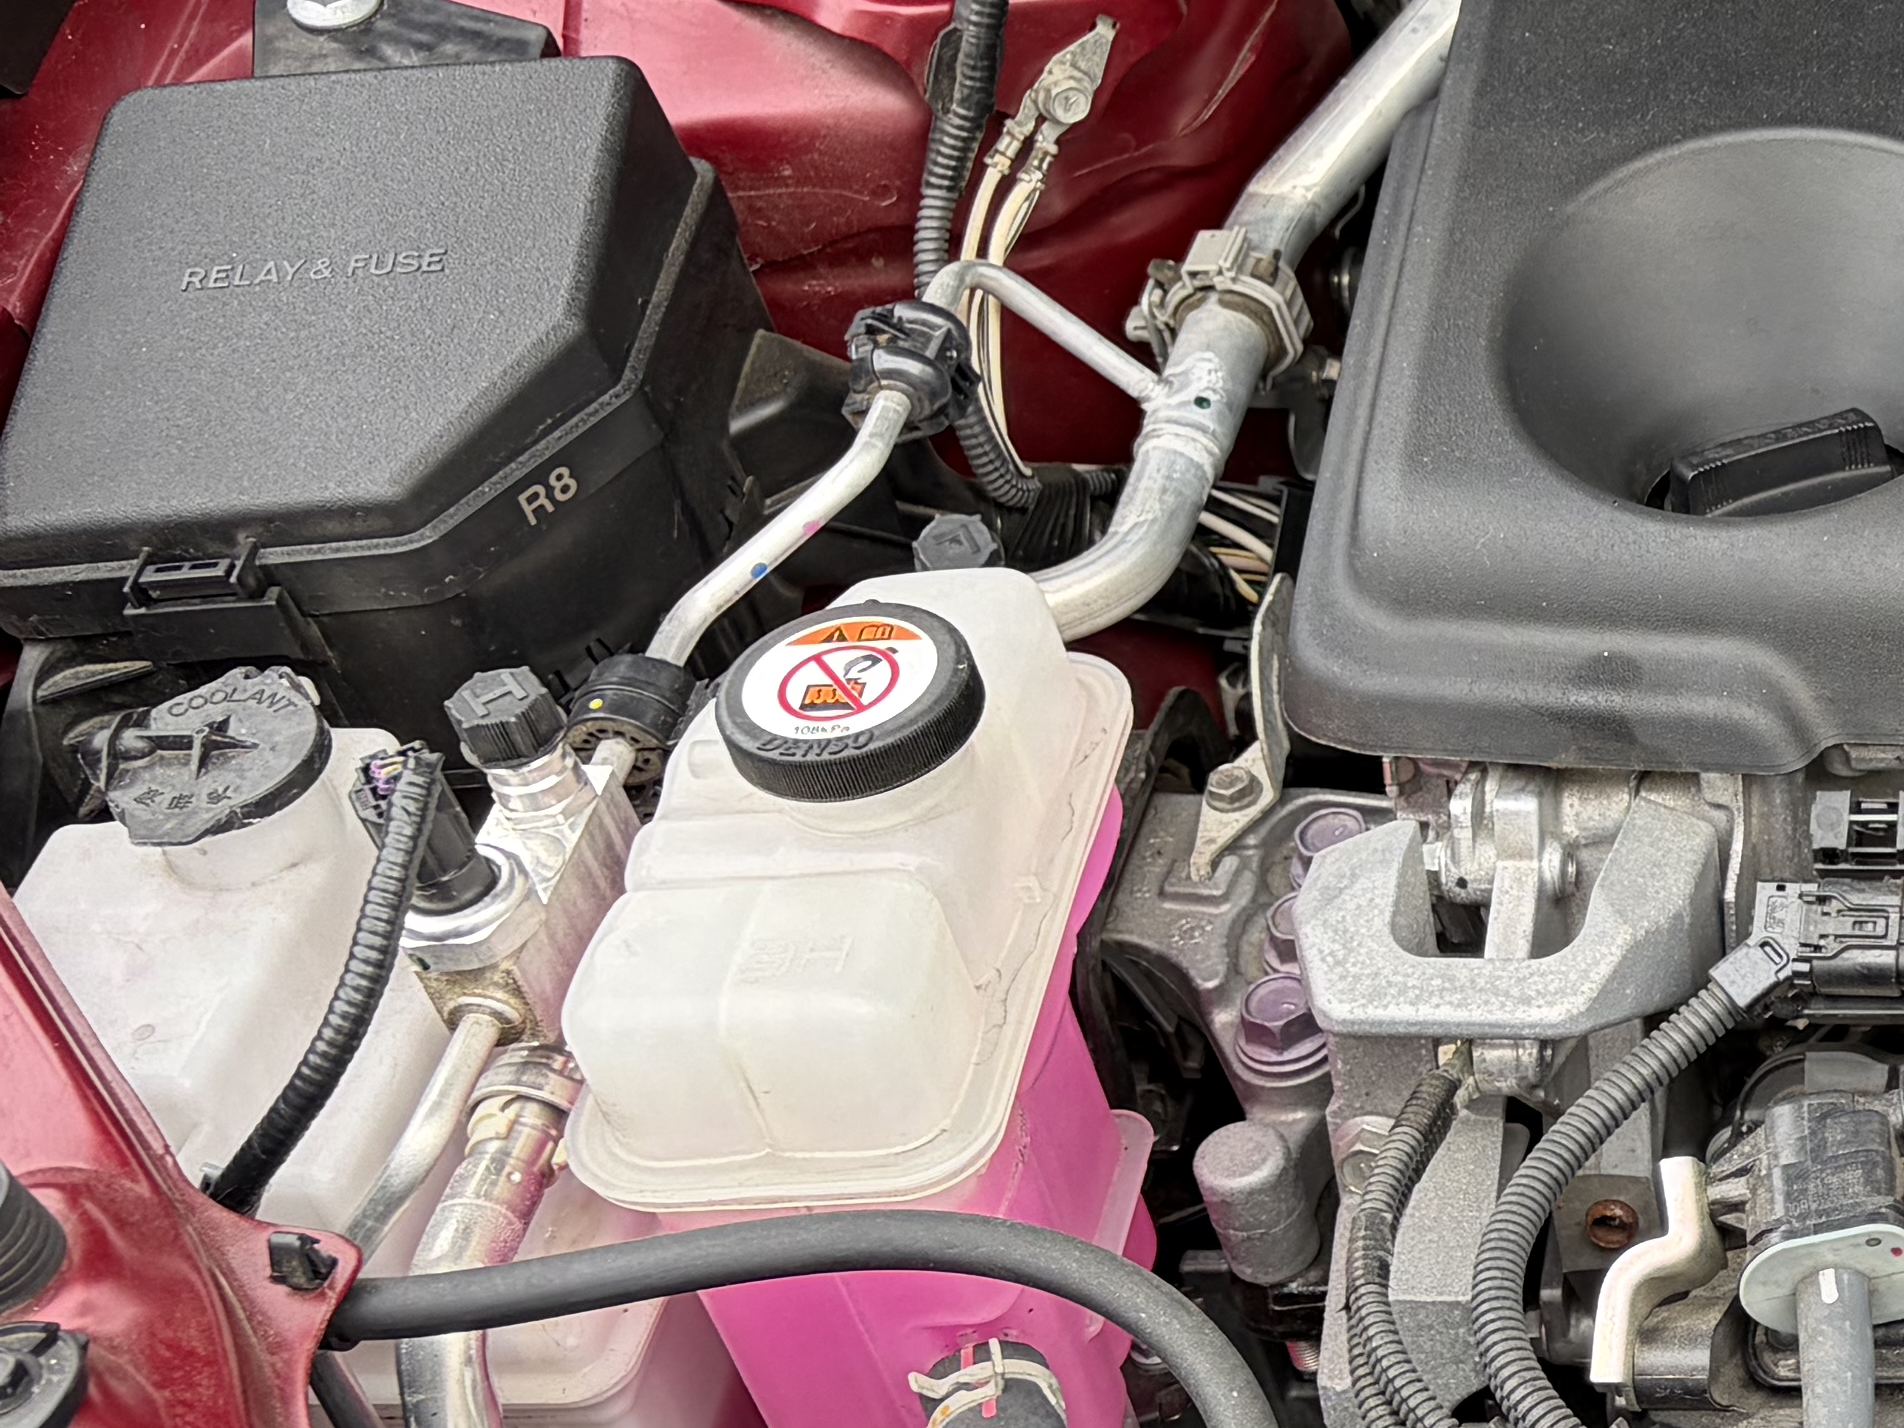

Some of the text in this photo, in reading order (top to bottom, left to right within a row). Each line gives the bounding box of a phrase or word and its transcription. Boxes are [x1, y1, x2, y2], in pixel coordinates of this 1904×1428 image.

[181, 248, 448, 292] RELAY & FUSE
[517, 464, 580, 527] R8
[167, 688, 299, 717] COOLANT
[461, 672, 529, 719] H
[755, 729, 876, 759] DENSO
